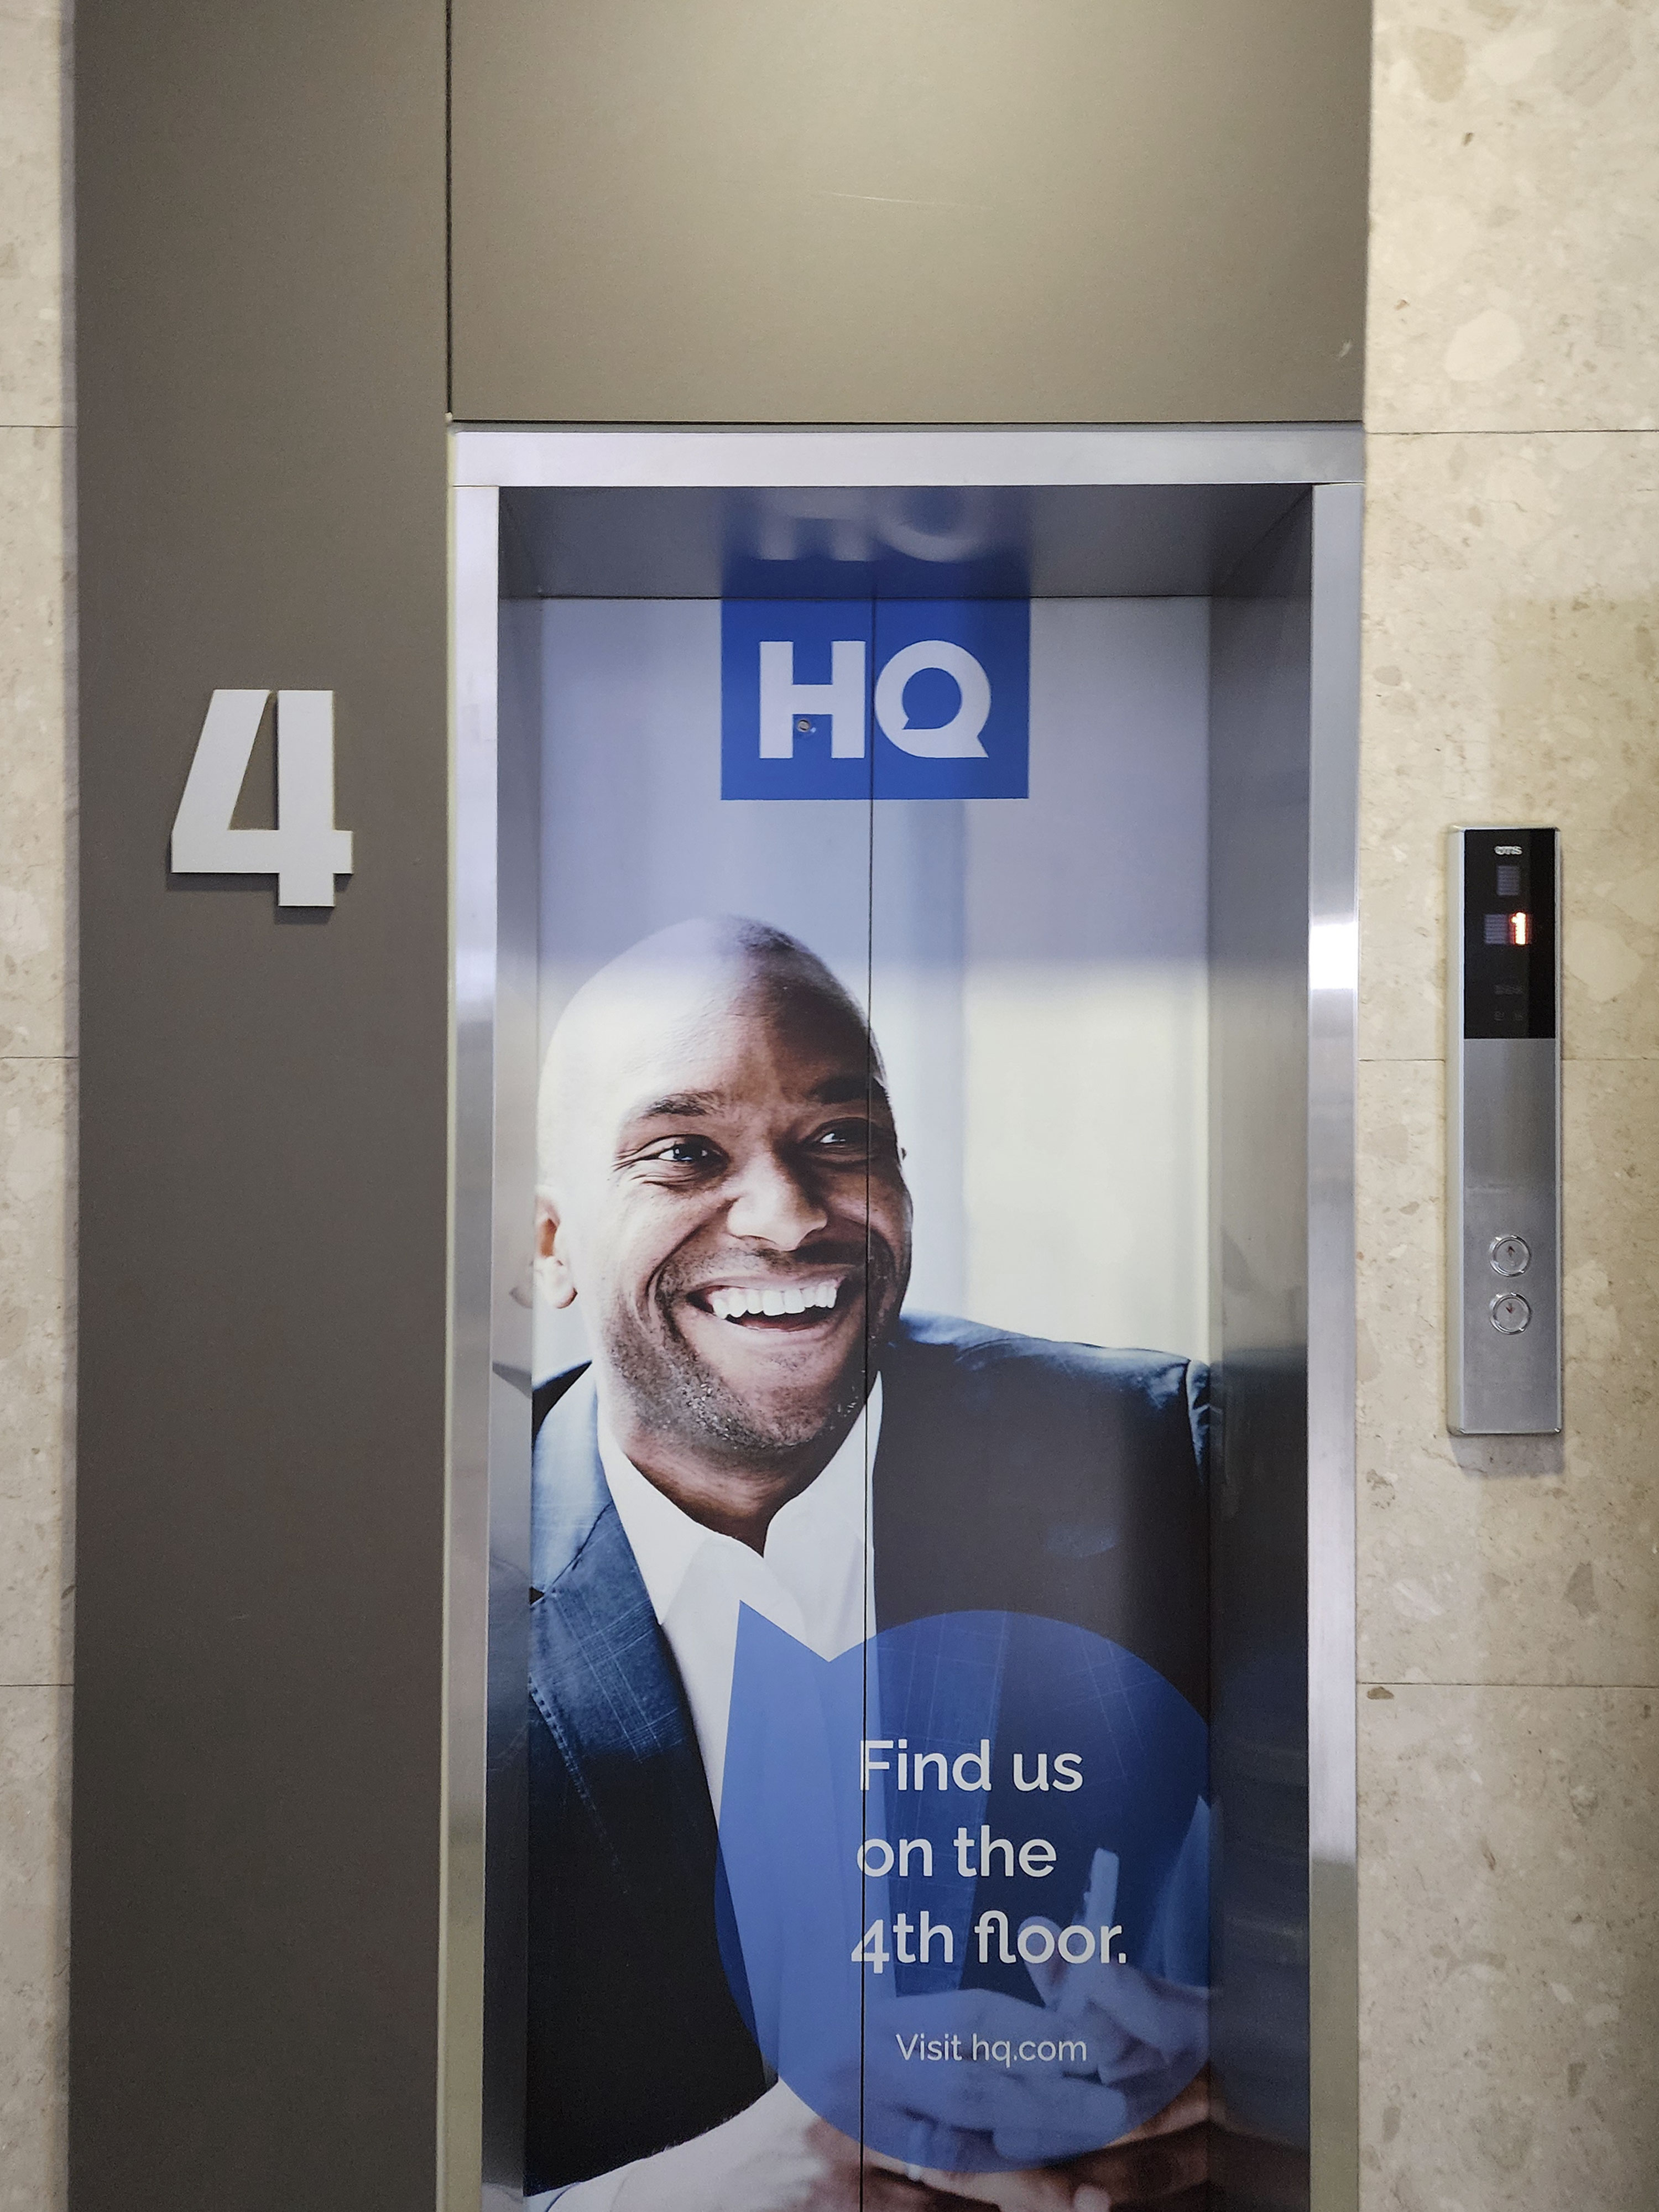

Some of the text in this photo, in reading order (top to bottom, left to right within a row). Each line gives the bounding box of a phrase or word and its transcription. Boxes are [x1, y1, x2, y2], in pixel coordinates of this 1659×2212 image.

[759, 640, 992, 758] HQ
[171, 689, 353, 906] 4
[1510, 911, 1527, 945] 1
[859, 1739, 1083, 1792] Find us
[857, 1825, 1057, 1877] on the
[851, 1911, 1126, 1974] 4th floor.
[896, 2033, 1087, 2068] Visit hq.com
